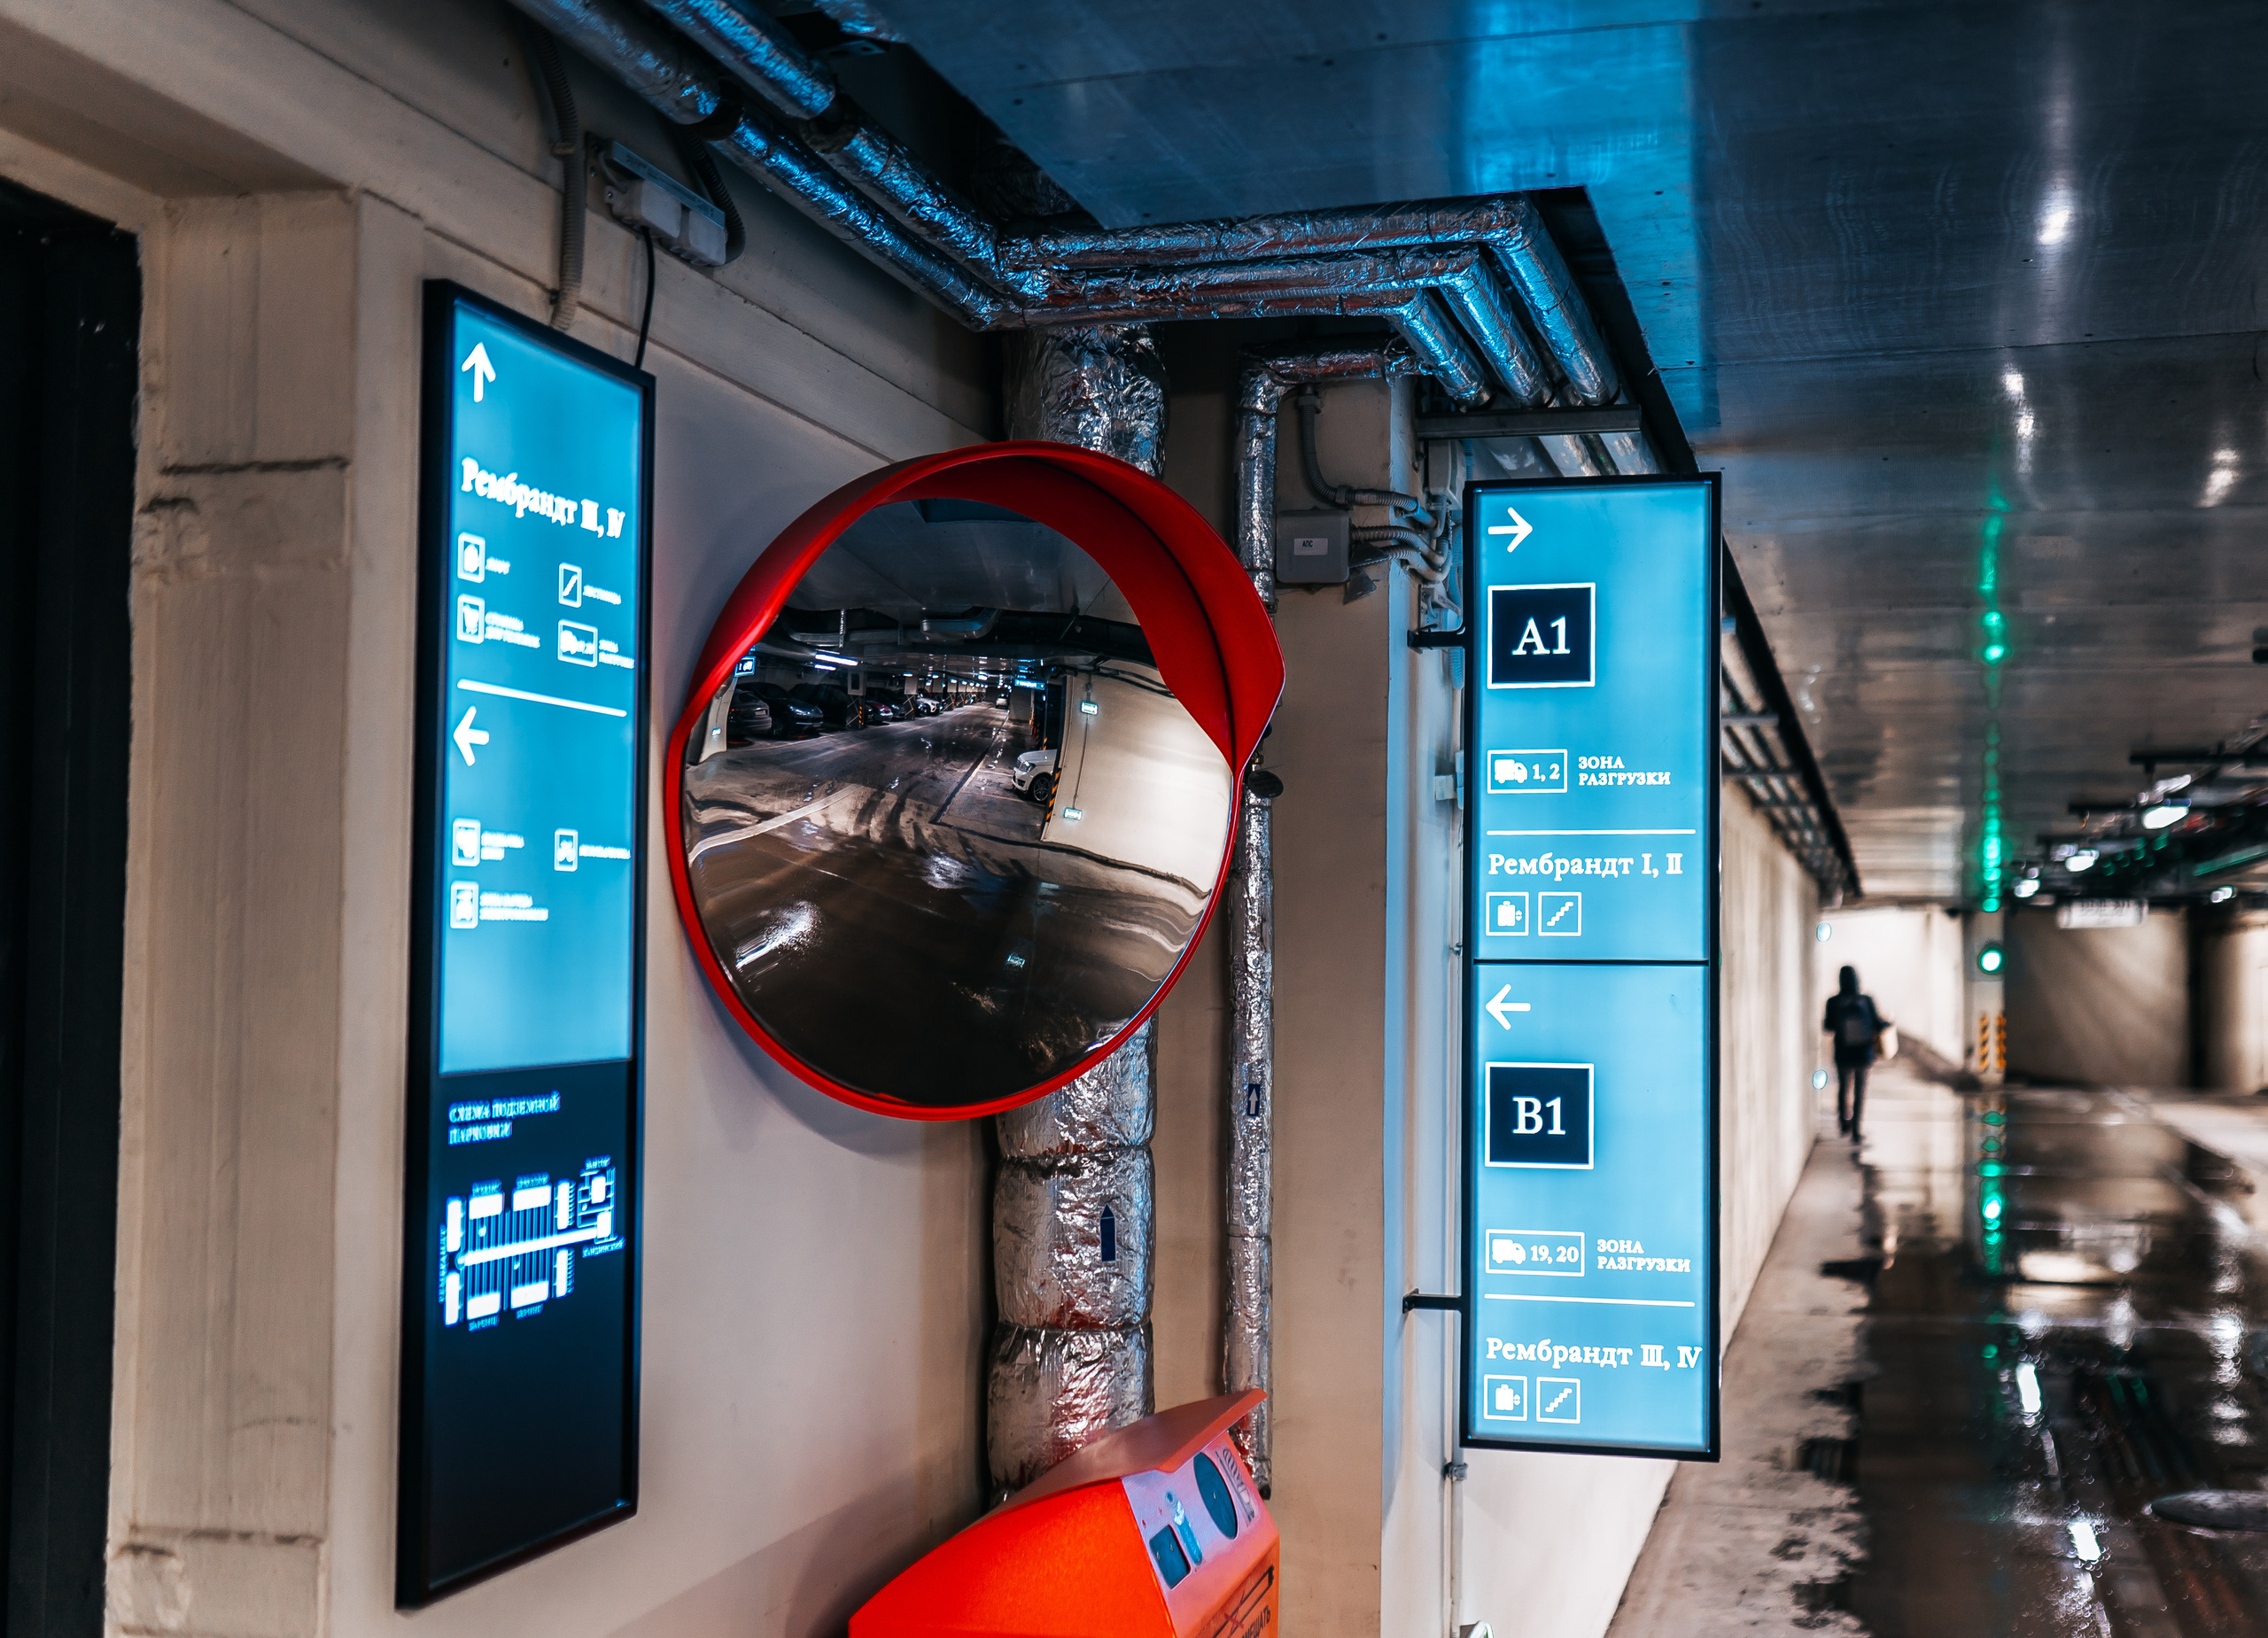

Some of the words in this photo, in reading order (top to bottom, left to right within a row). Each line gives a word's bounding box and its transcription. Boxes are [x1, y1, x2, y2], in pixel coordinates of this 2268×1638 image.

[461, 457, 578, 526] Рембрандт
[1511, 616, 1571, 655] A1
[1532, 764, 1546, 781] 1,
[1549, 764, 1560, 780] 2
[1578, 756, 1625, 770] ЗОНА
[1579, 772, 1671, 786] РАЗГРУЗКИ
[1487, 852, 1634, 881] Рембрандт
[1642, 853, 1659, 878] I,
[1511, 1096, 1566, 1135] B1
[1530, 1245, 1553, 1264] 19,
[1556, 1246, 1579, 1263] 20
[1596, 1238, 1644, 1254] ЗОНА
[1596, 1256, 1691, 1273] РАЗГРУЗКИ
[1486, 1338, 1634, 1369] Рембрандт
